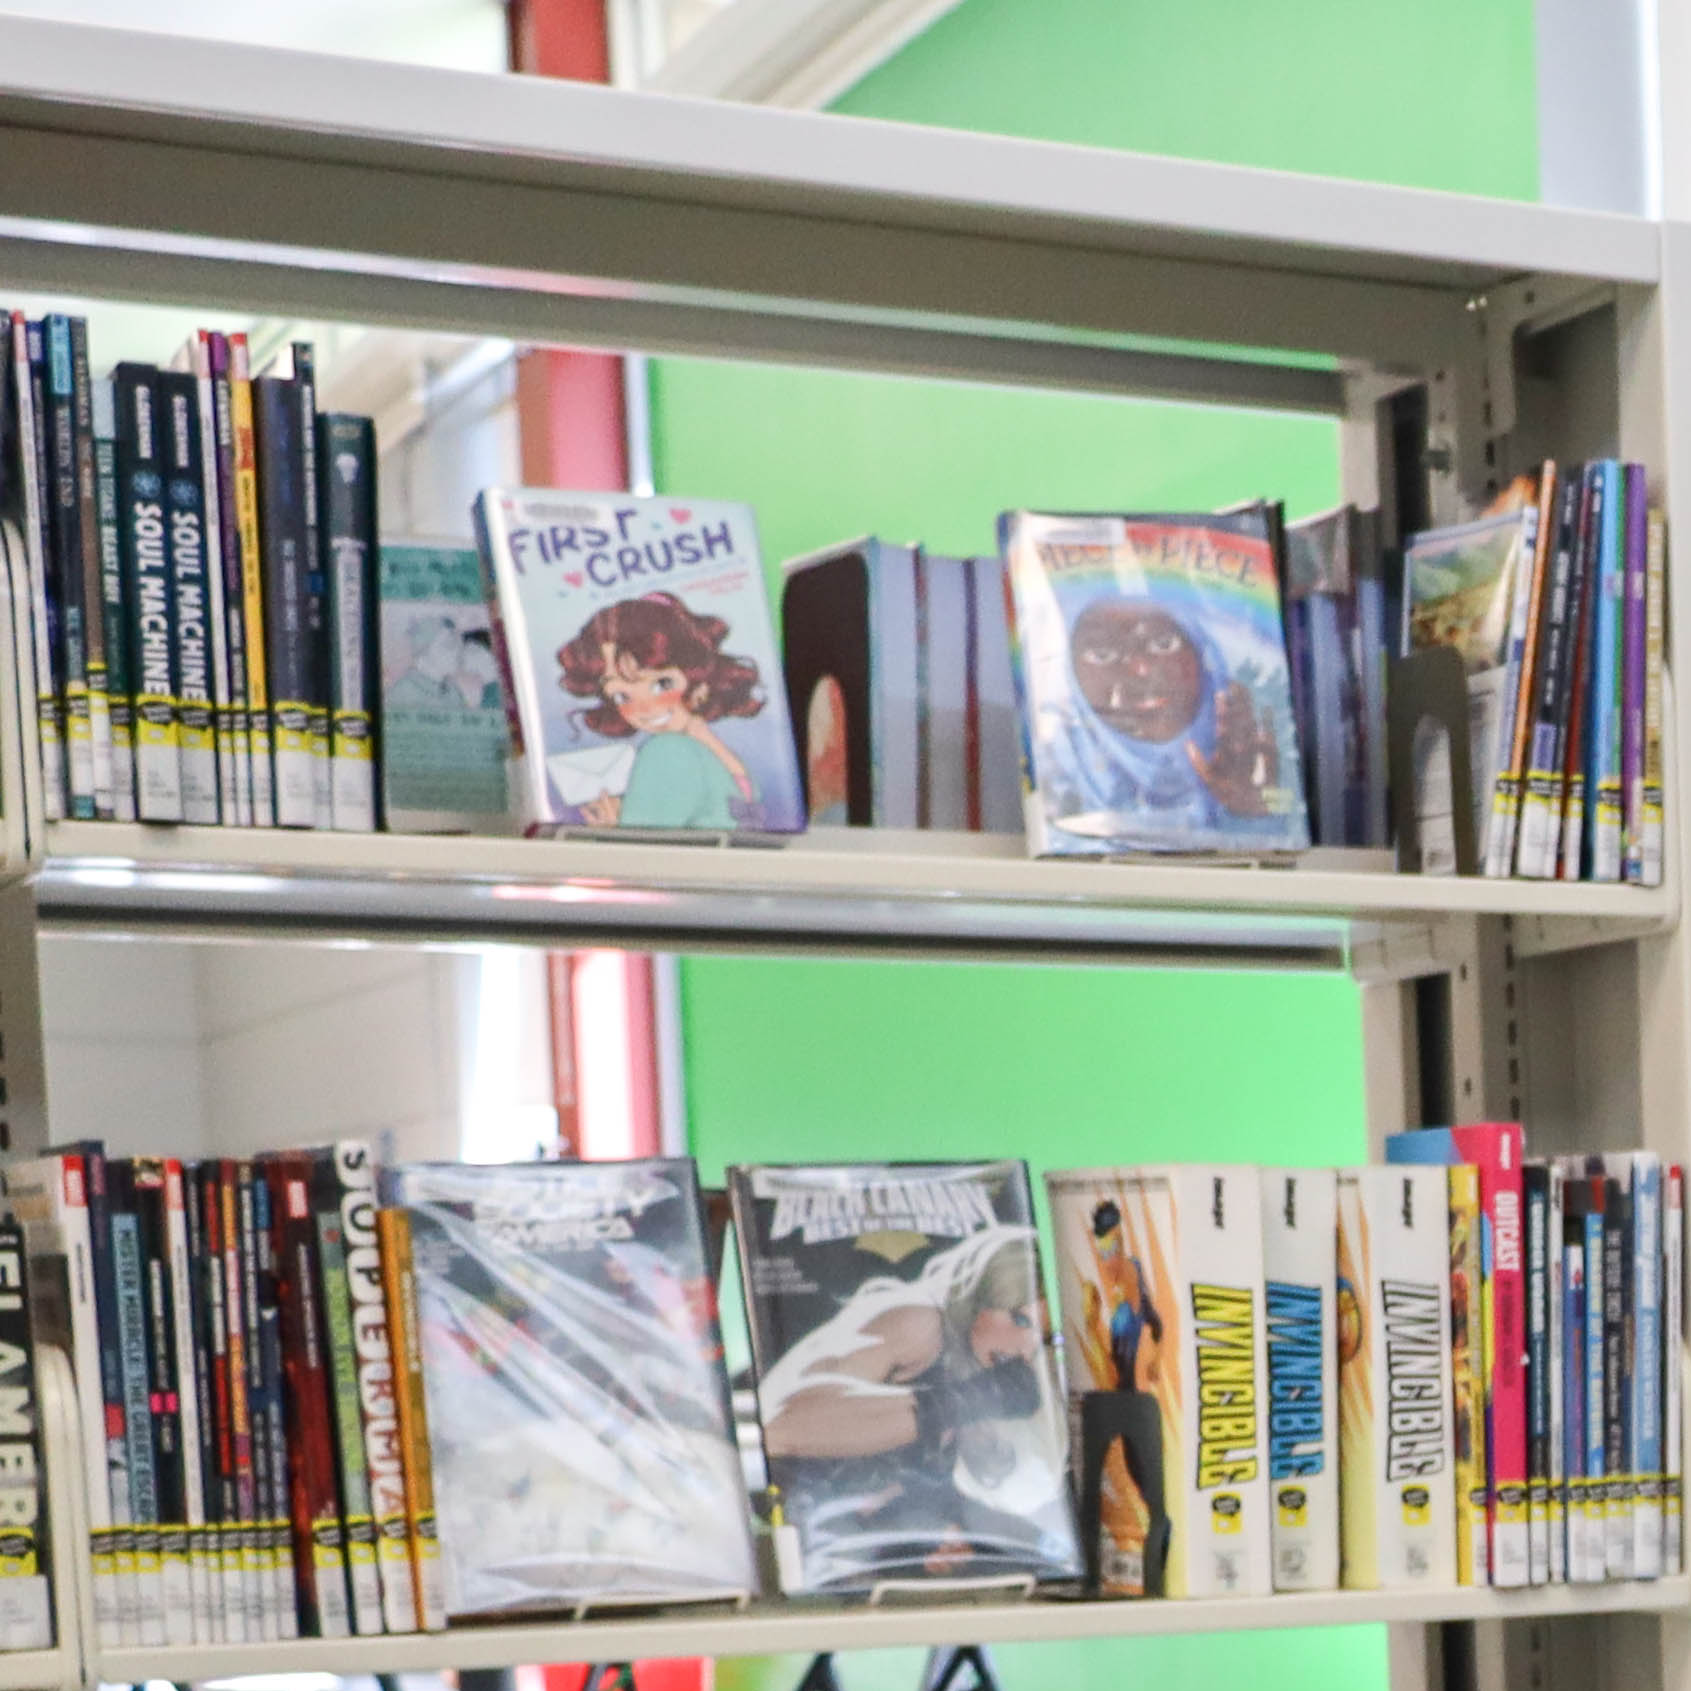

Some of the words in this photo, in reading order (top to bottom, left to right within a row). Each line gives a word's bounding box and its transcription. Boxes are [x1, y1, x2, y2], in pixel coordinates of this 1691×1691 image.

[134, 502, 165, 571] SOUL
[171, 510, 202, 580] SOUL
[507, 508, 637, 576] FIRST
[584, 520, 734, 588] CRUSH
[105, 574, 120, 604] BOY
[138, 576, 170, 695] MACHINE
[176, 585, 208, 702] MACHINE
[1494, 1191, 1520, 1270] OUTCAST
[1191, 1283, 1258, 1490] INVINCIBLE
[1264, 1281, 1325, 1481] INVINCIBLE
[1382, 1280, 1445, 1482] INVINCIBLE
